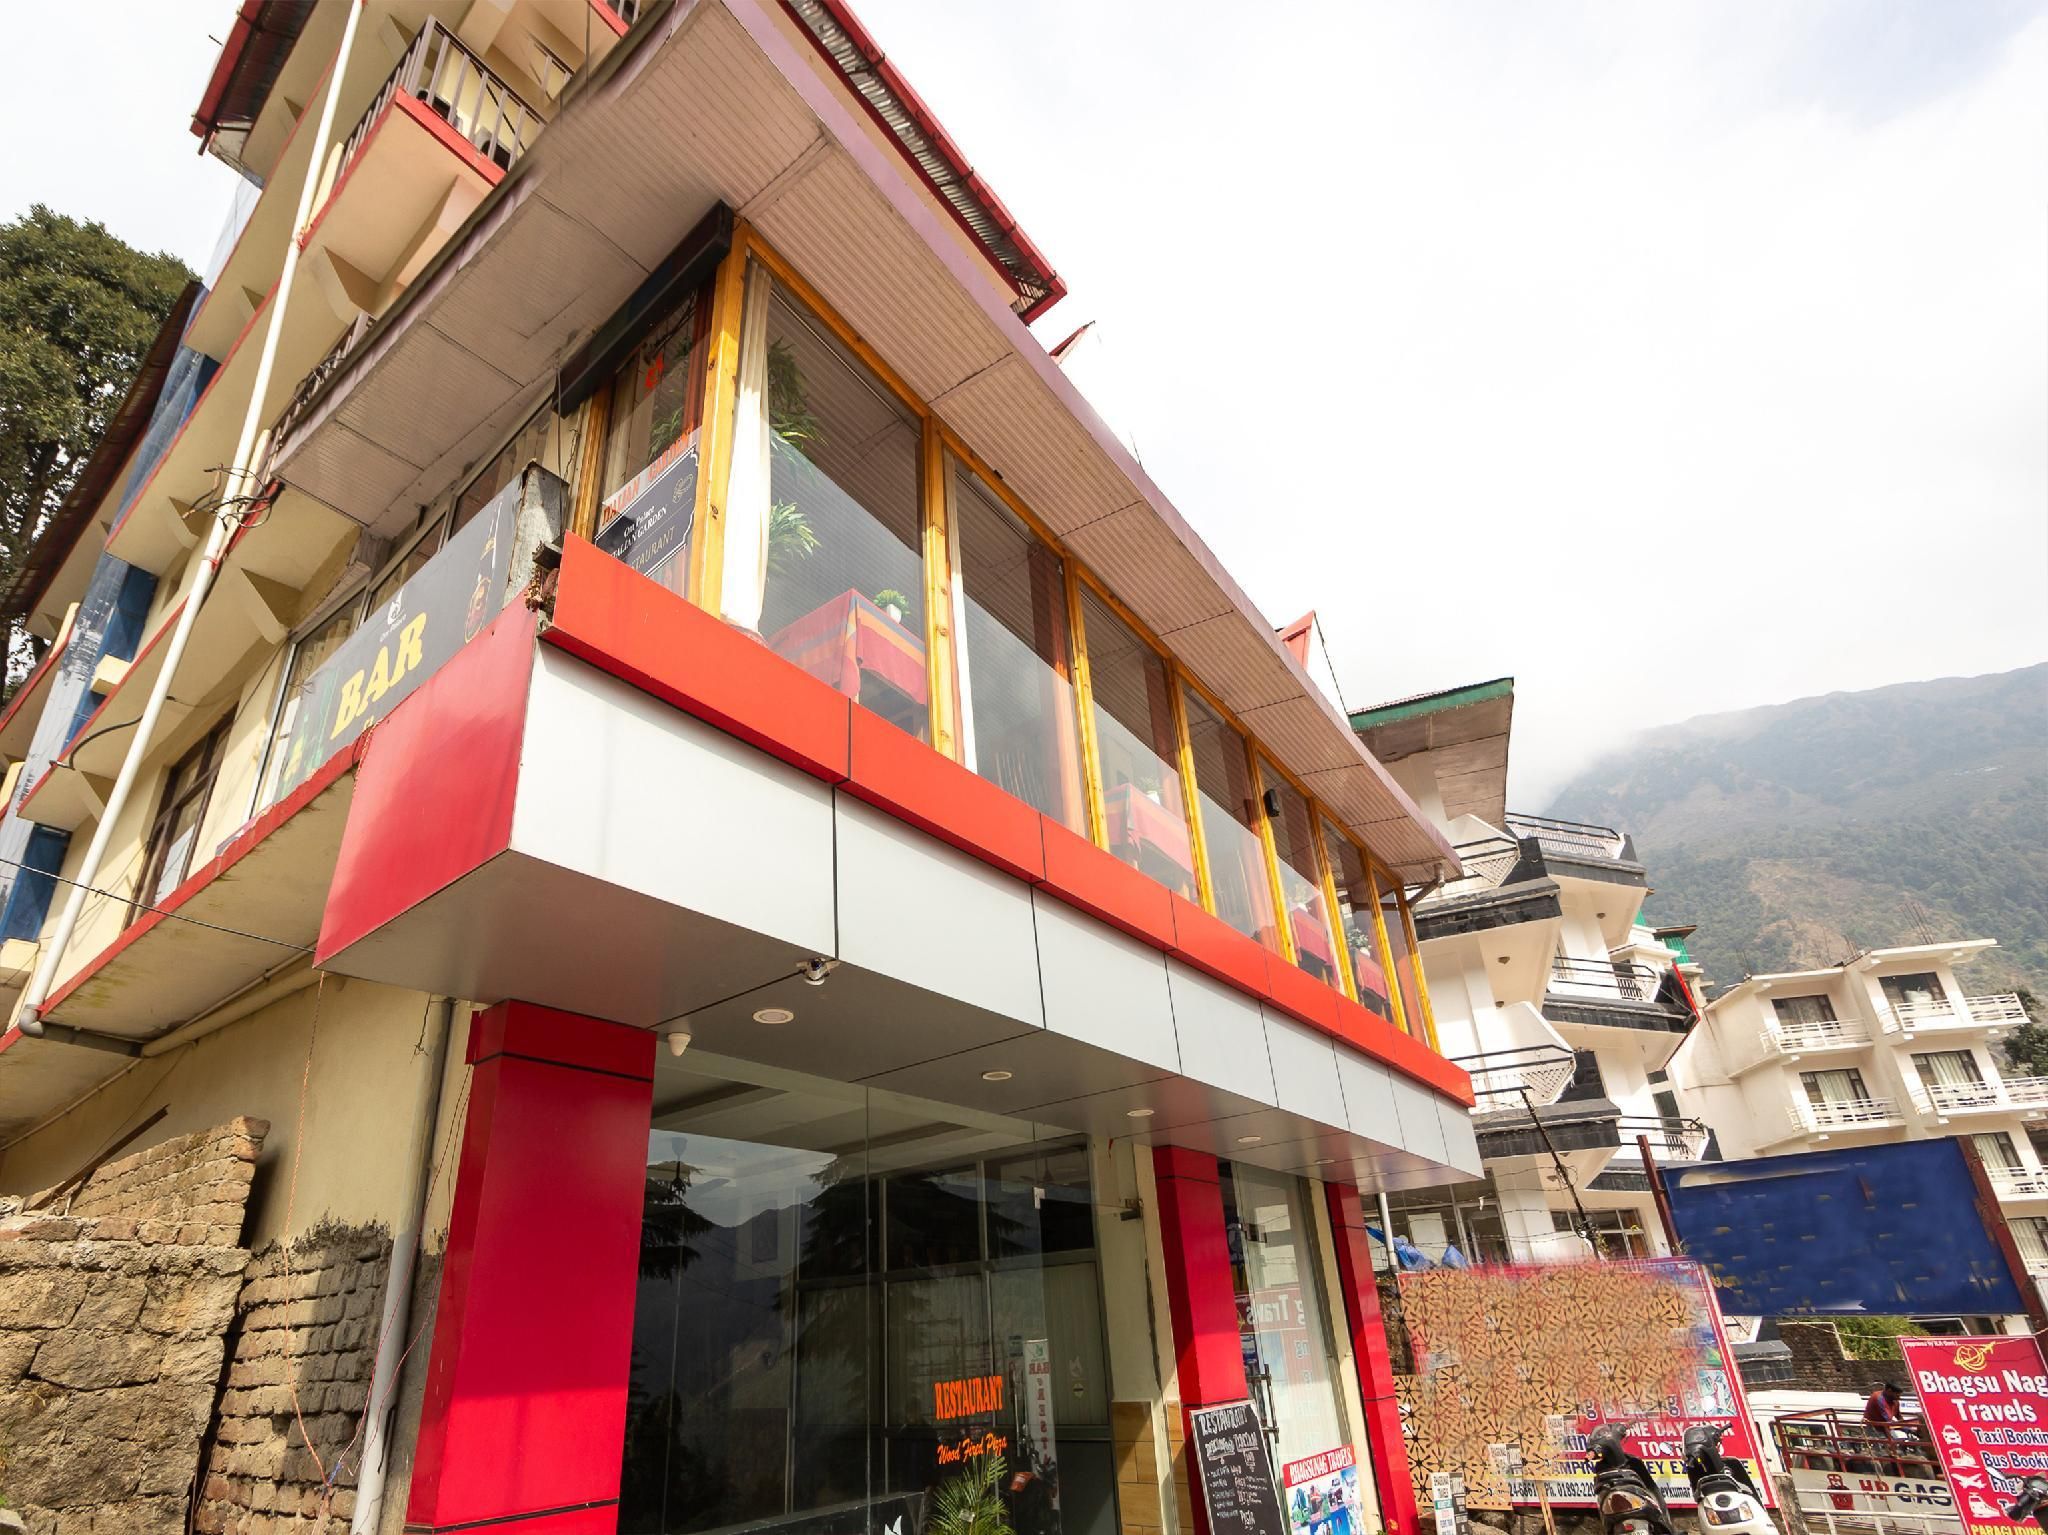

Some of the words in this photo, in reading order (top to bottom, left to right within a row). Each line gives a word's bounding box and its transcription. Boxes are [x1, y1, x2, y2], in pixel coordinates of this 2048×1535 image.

[612, 533, 638, 558] TALIAN
[637, 506, 668, 538] GARDEN
[330, 612, 427, 741] BAR
[1918, 1370, 2002, 1398] Bhagsu
[934, 1375, 1003, 1420] RESTAURANT
[1951, 1398, 2038, 1423] Travels
[1198, 1405, 1248, 1437] RESTAURANT
[1653, 1421, 1685, 1437] DAY
[937, 1442, 961, 1465] Wood
[962, 1438, 984, 1463] Fired
[985, 1432, 1007, 1457] Pizza
[1971, 1427, 2005, 1444] Taxi
[1327, 1447, 1353, 1472] TRAVELS
[1638, 1441, 1659, 1457] TO
[1980, 1450, 2010, 1469] Bus
[1543, 1482, 1557, 1497] Ph.
[1557, 1482, 1596, 1497] 01892-220
[1858, 1479, 1890, 1500] HP
[1894, 1482, 1952, 1507] GAS
